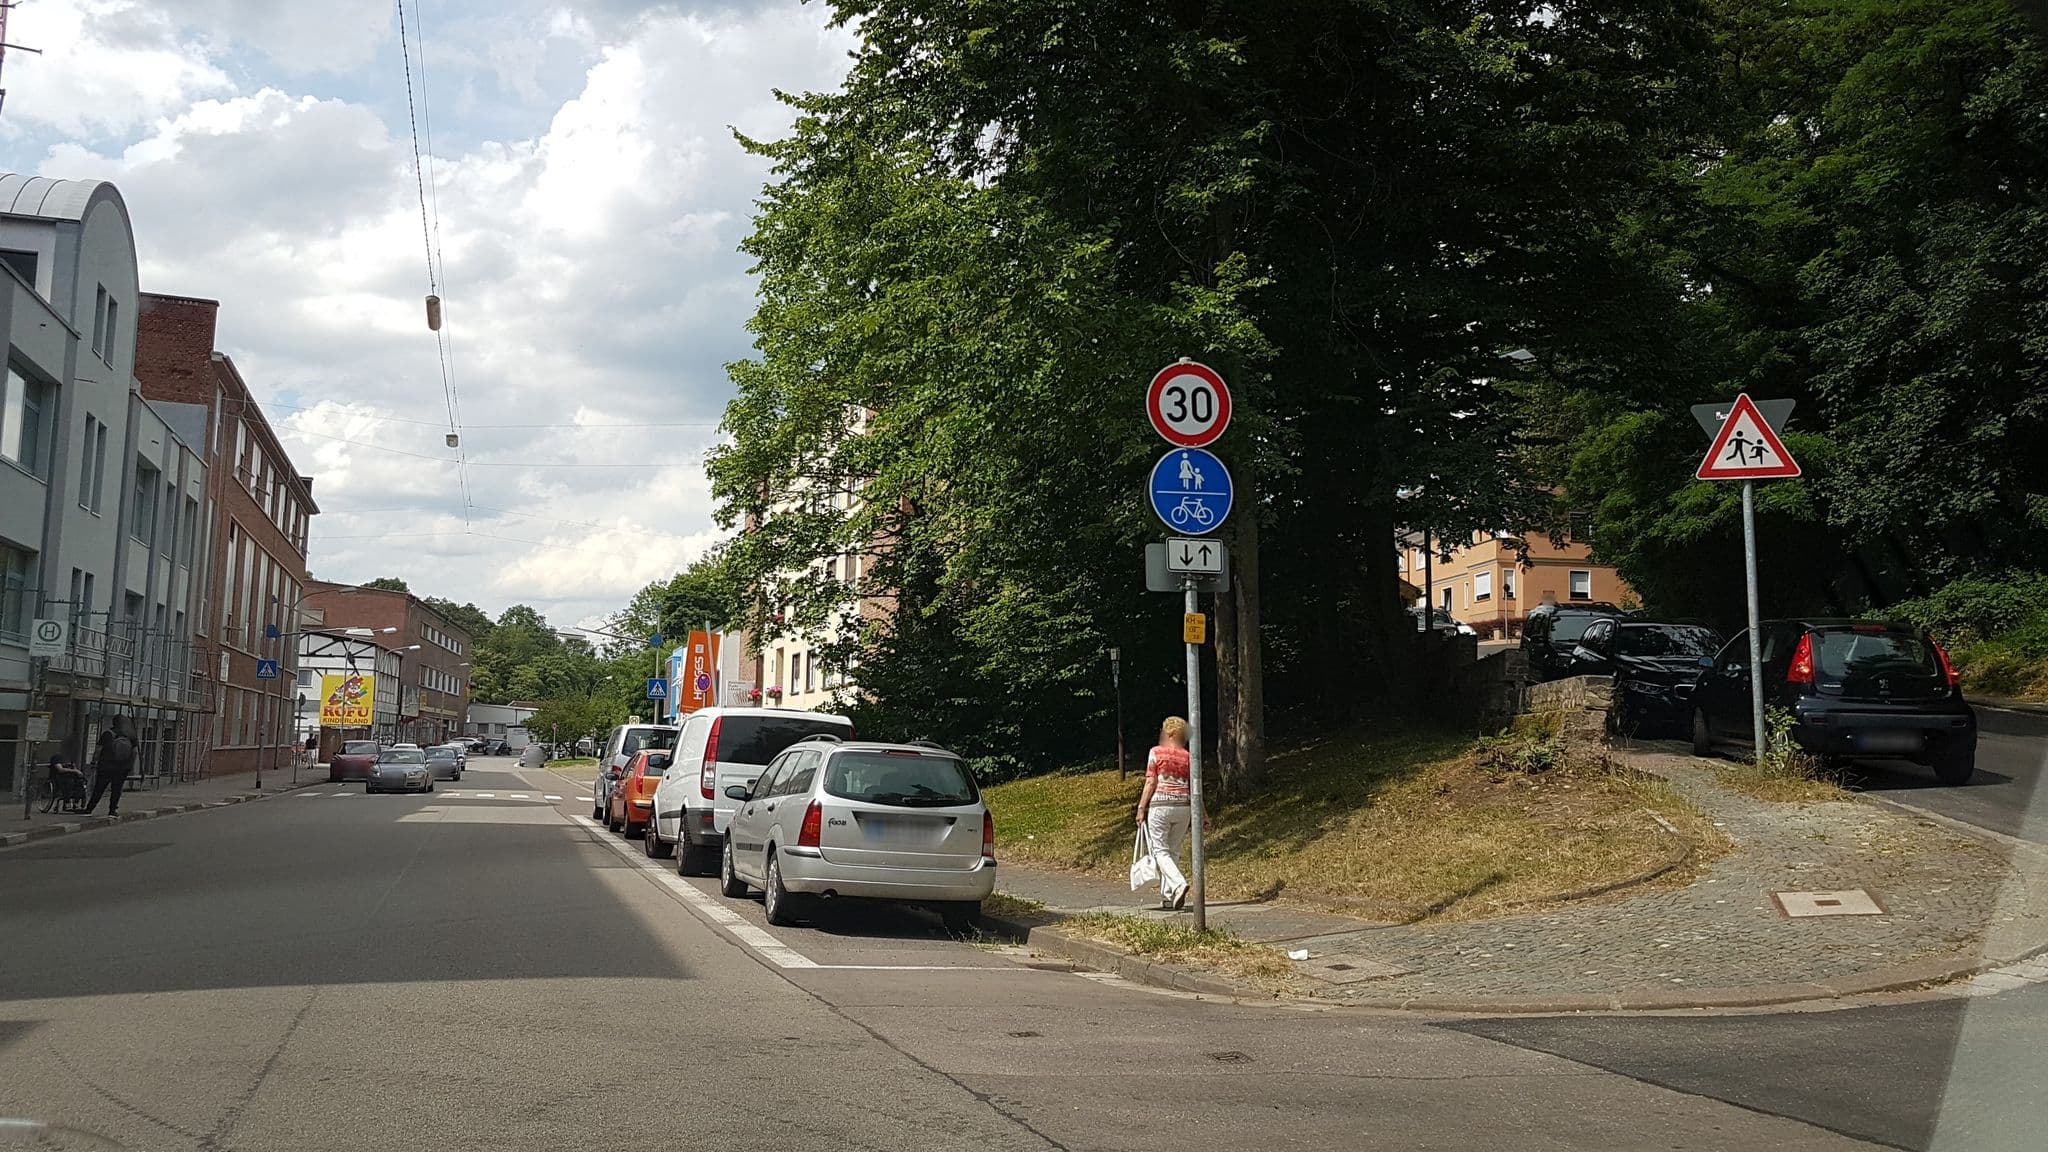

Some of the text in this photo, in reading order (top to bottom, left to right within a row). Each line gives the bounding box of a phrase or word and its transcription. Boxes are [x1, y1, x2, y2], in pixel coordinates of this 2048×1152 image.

[1166, 386, 1213, 423] 30
[44, 626, 55, 637] H
[323, 706, 369, 717] ROFU
